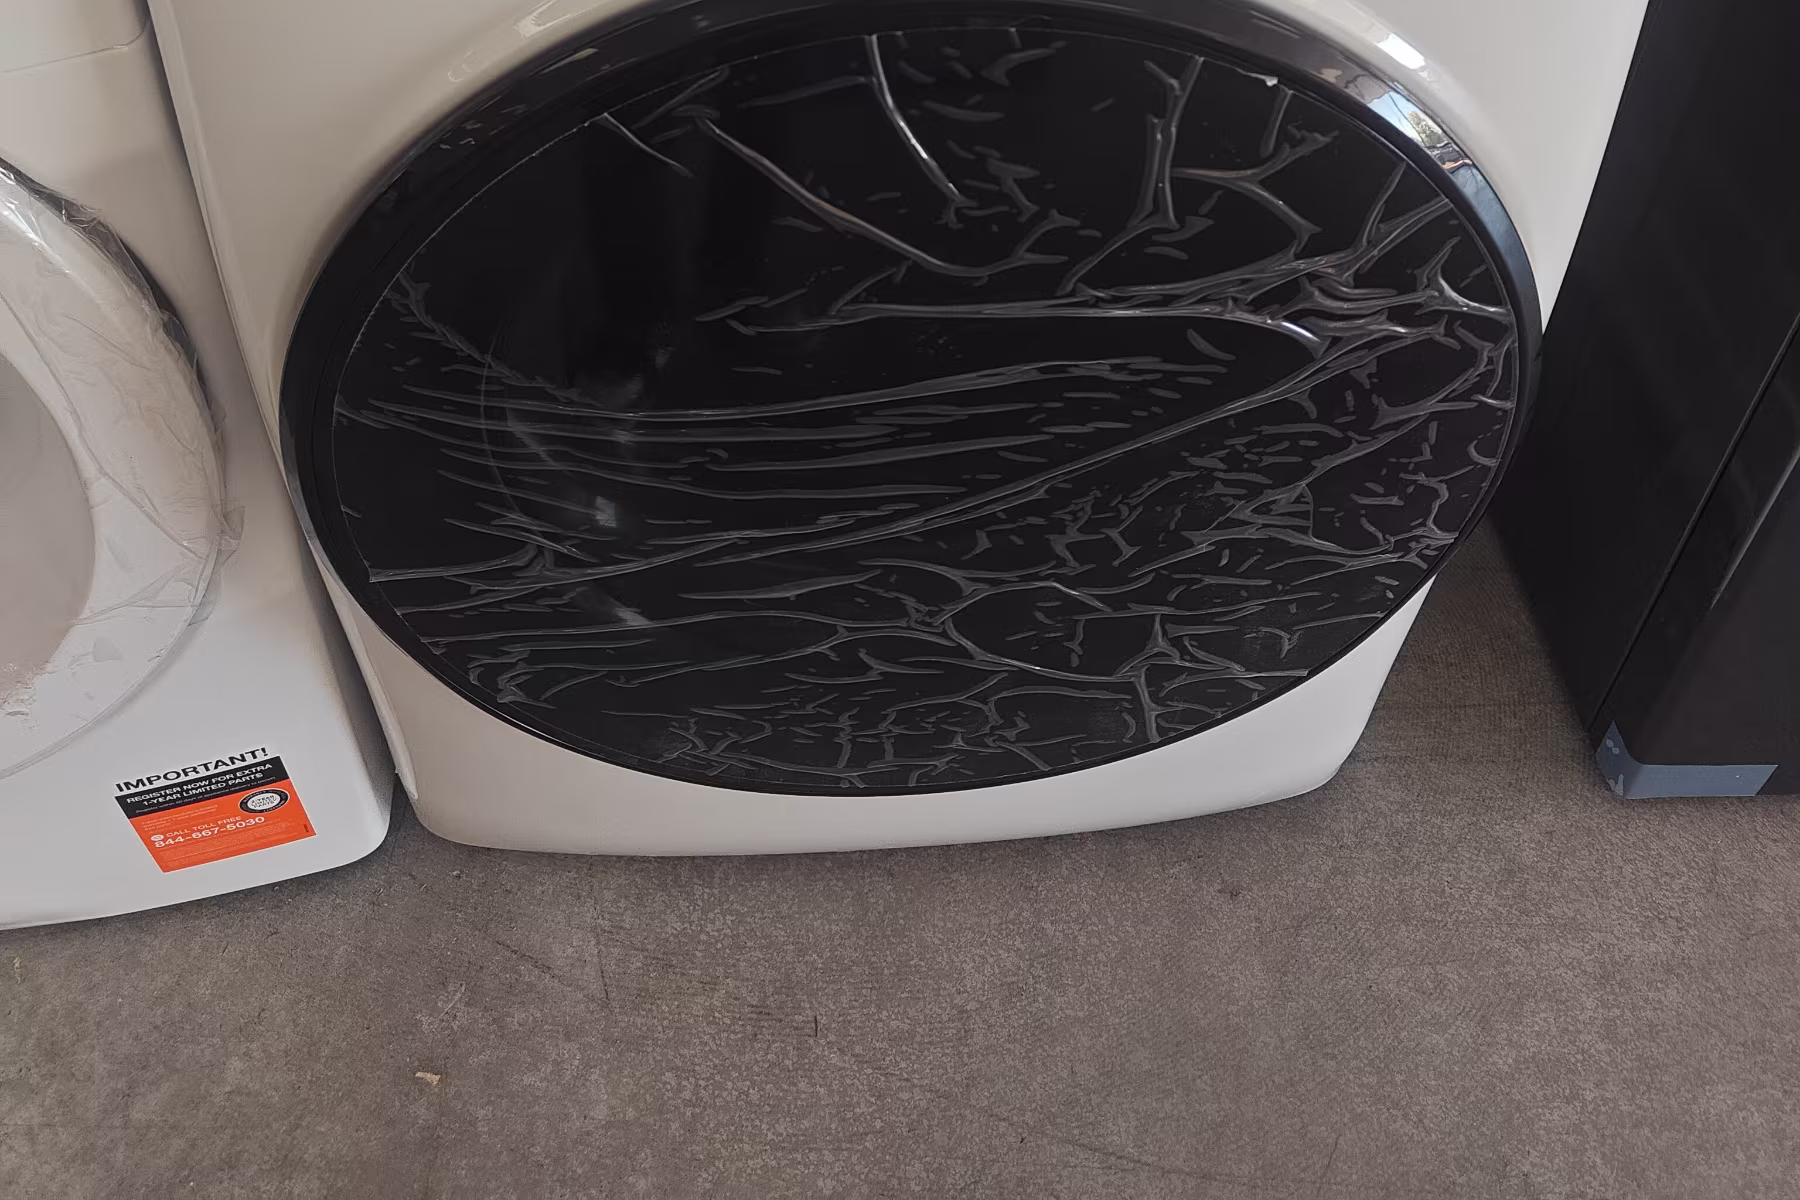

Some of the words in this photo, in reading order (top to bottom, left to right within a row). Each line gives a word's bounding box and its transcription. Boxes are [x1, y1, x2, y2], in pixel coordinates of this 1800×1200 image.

[115, 747, 268, 792] IMPORTANT!
[126, 787, 181, 803] REGISTER
[184, 780, 210, 792] NOW
[212, 774, 234, 785] FOR
[236, 763, 272, 778] EXTRA
[143, 793, 182, 806] 1-YEAR
[185, 783, 226, 798] LIMITED
[229, 772, 263, 786] PARTS
[154, 816, 265, 848] 844-667-5030
[192, 823, 216, 831] TOLL
[218, 816, 242, 825] FREE
